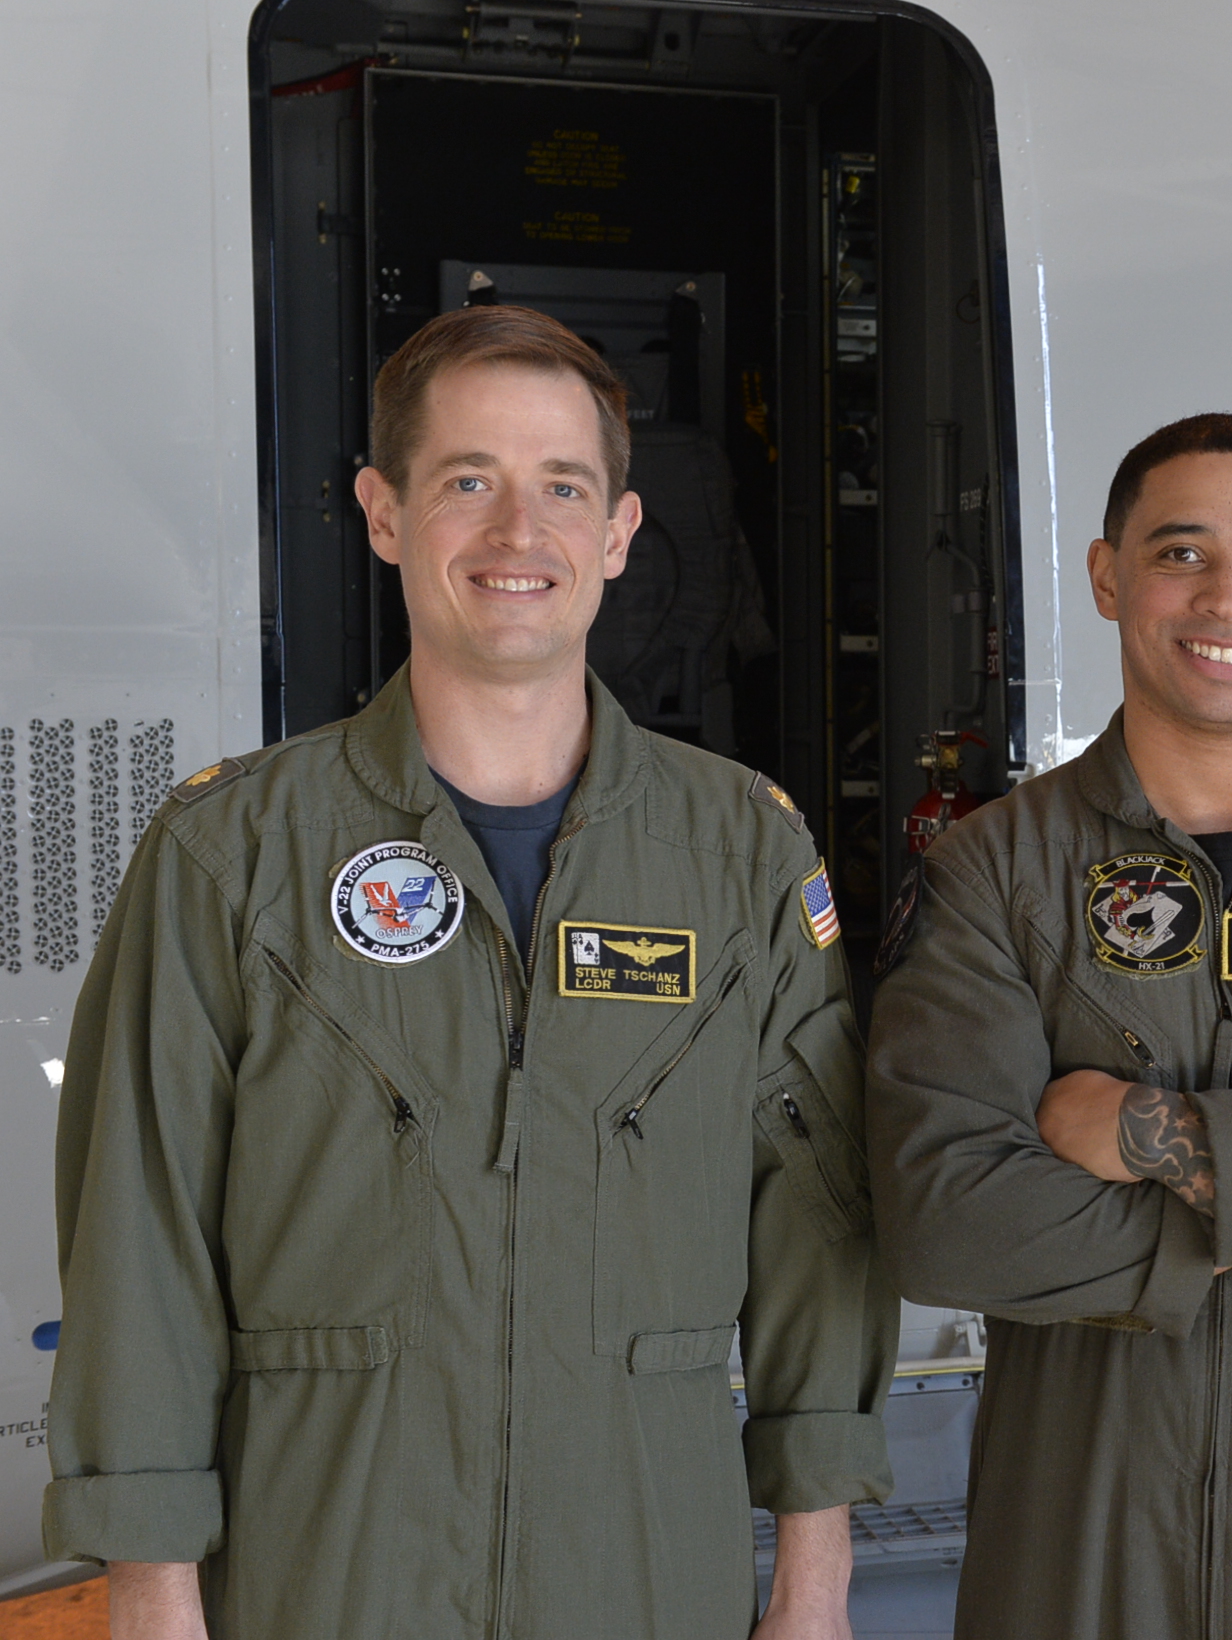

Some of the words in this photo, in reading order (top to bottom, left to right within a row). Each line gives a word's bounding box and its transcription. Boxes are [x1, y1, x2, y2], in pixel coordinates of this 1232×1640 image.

[554, 211, 600, 222] CAUTION
[1115, 856, 1166, 868] BLACKJACK
[338, 885, 351, 915] V-22
[345, 855, 373, 884] JOINT
[374, 847, 438, 867] PROGRAM
[436, 865, 458, 903] OFFICE
[402, 878, 425, 892] 22
[375, 925, 424, 940] OSPREY
[370, 940, 430, 957] PMA-275
[1138, 962, 1165, 971] HX-21
[575, 967, 616, 979] STEVE
[623, 970, 680, 984] TSCHANZ
[575, 978, 611, 990] LCDR
[656, 983, 681, 996] USN
